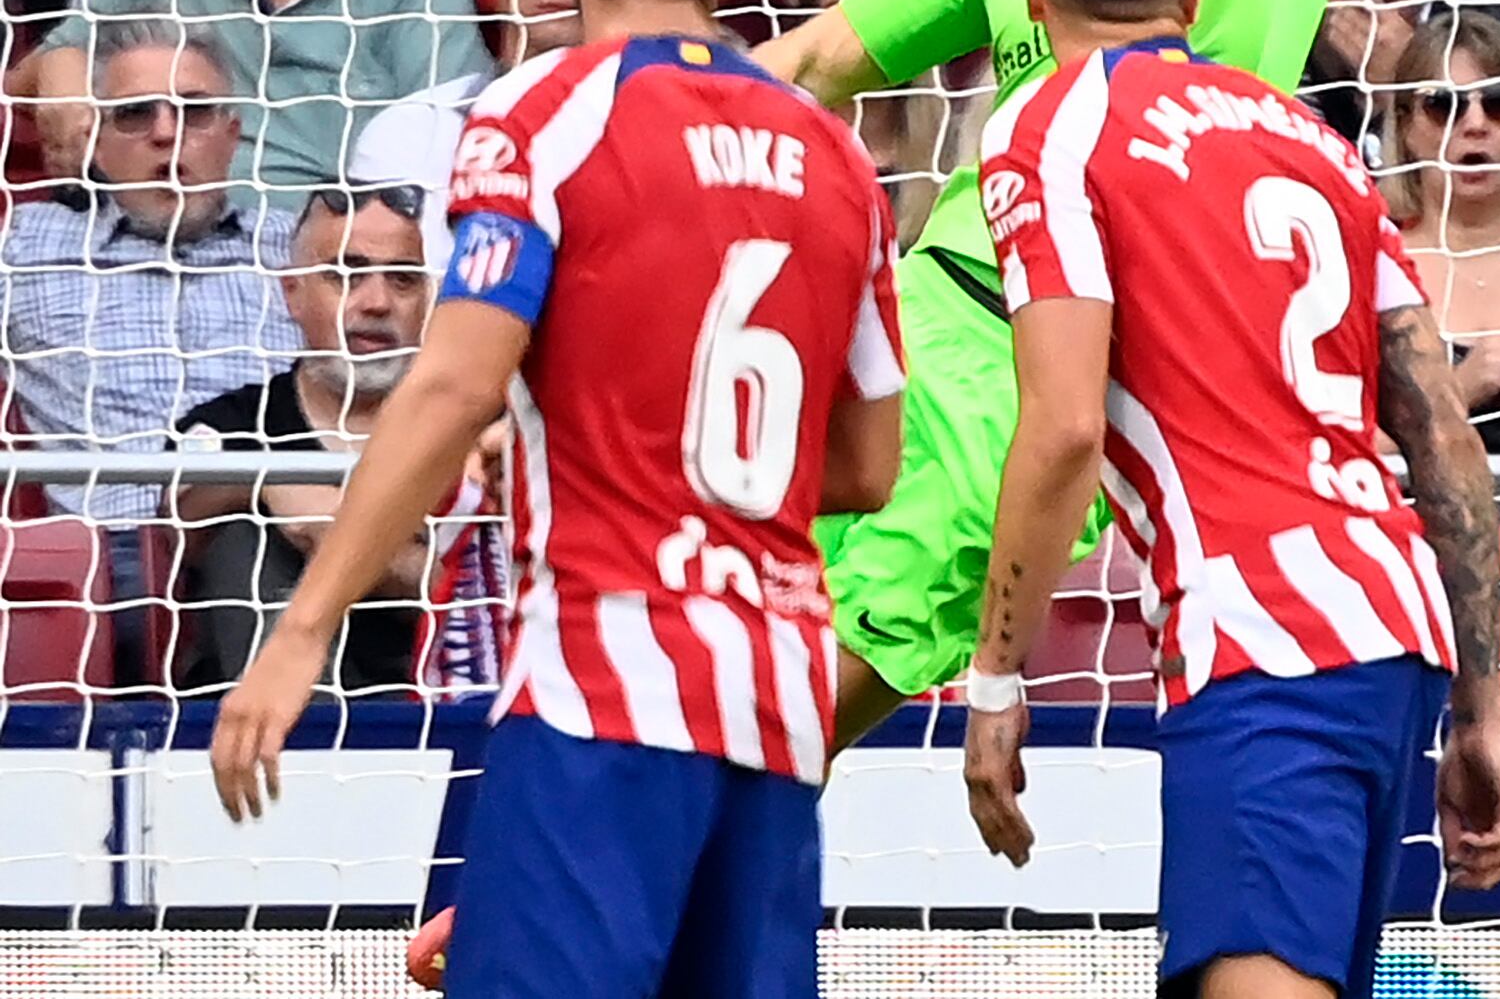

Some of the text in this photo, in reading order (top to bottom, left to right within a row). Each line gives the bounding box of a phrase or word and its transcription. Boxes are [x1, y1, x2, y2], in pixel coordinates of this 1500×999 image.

[684, 125, 806, 199] KOKE
[680, 238, 804, 521] 6
[1243, 175, 1364, 432] 2
